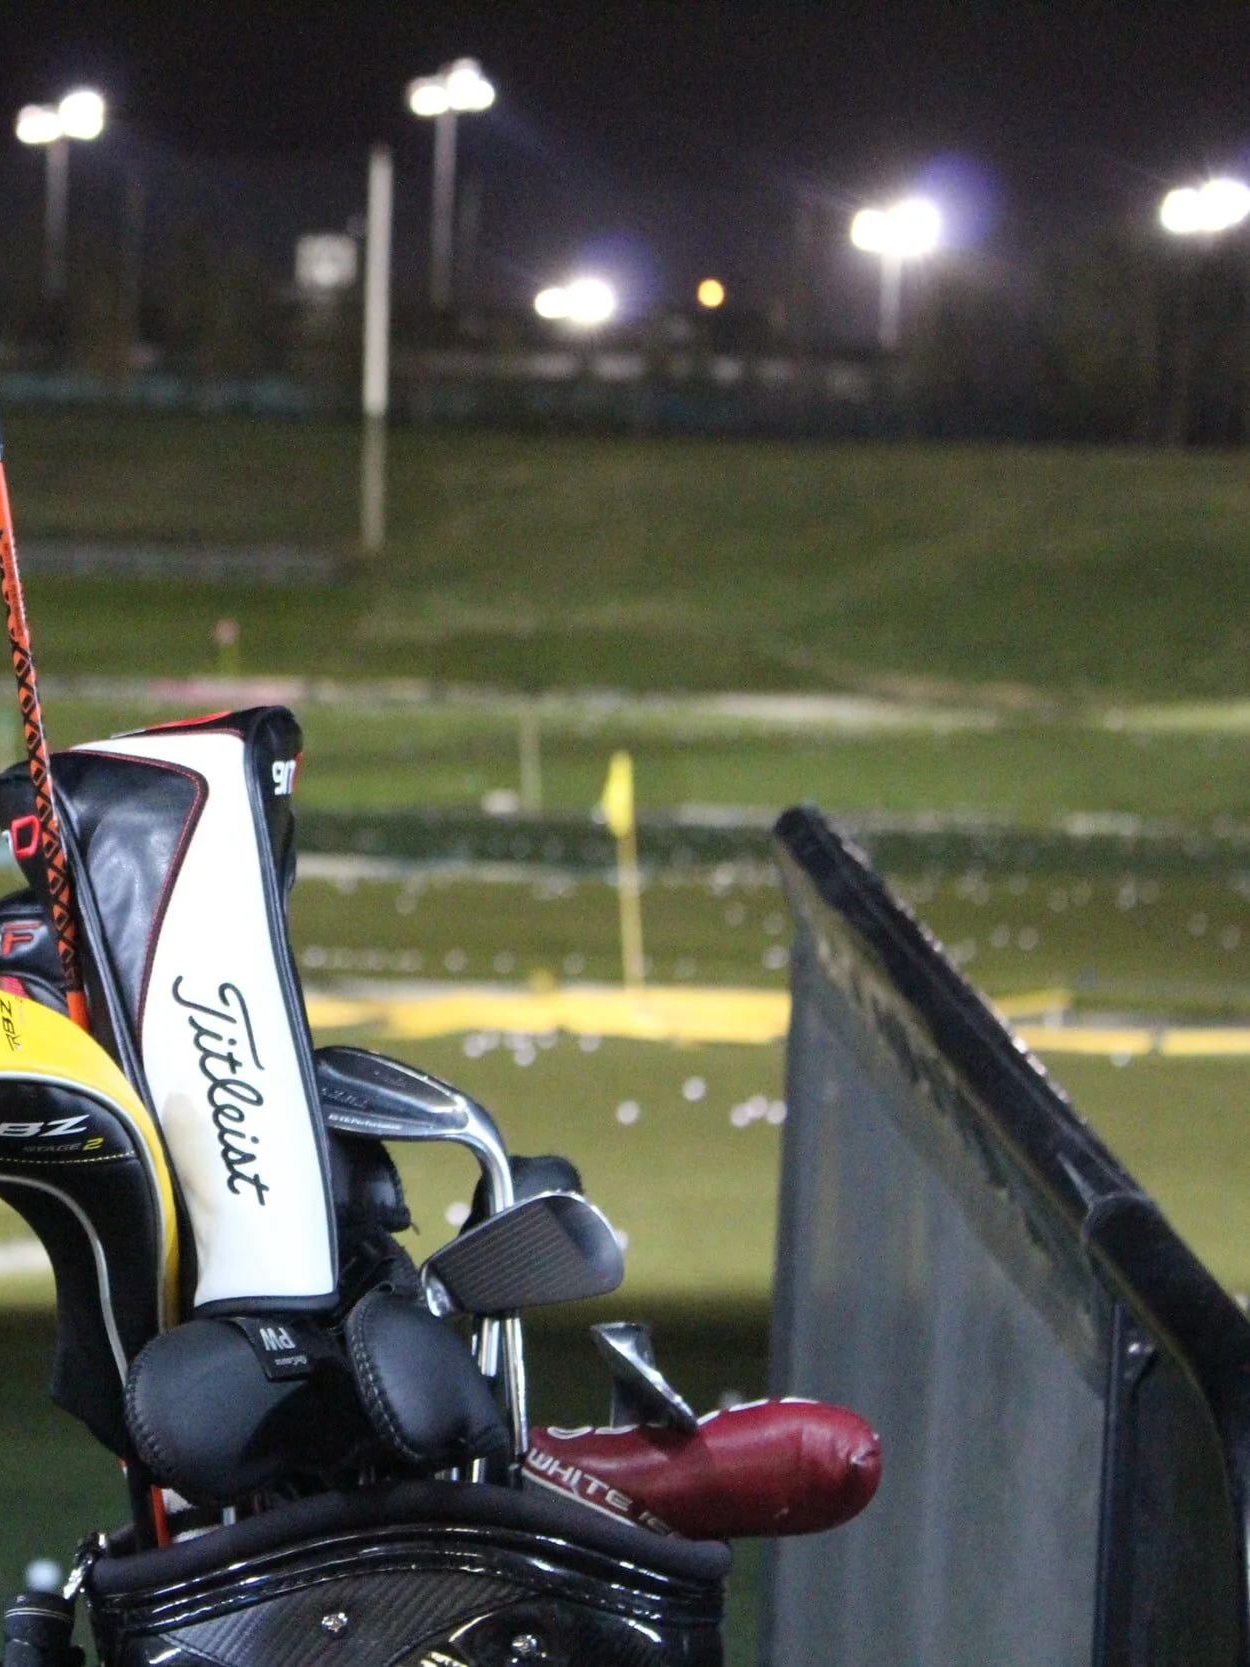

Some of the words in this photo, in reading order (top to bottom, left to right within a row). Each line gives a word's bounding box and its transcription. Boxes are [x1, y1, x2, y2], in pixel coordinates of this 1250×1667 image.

[172, 975, 270, 1206] Titleist
[82, 1137, 104, 1151] 2
[259, 1327, 296, 1351] PW
[524, 1449, 633, 1511] WHITE
